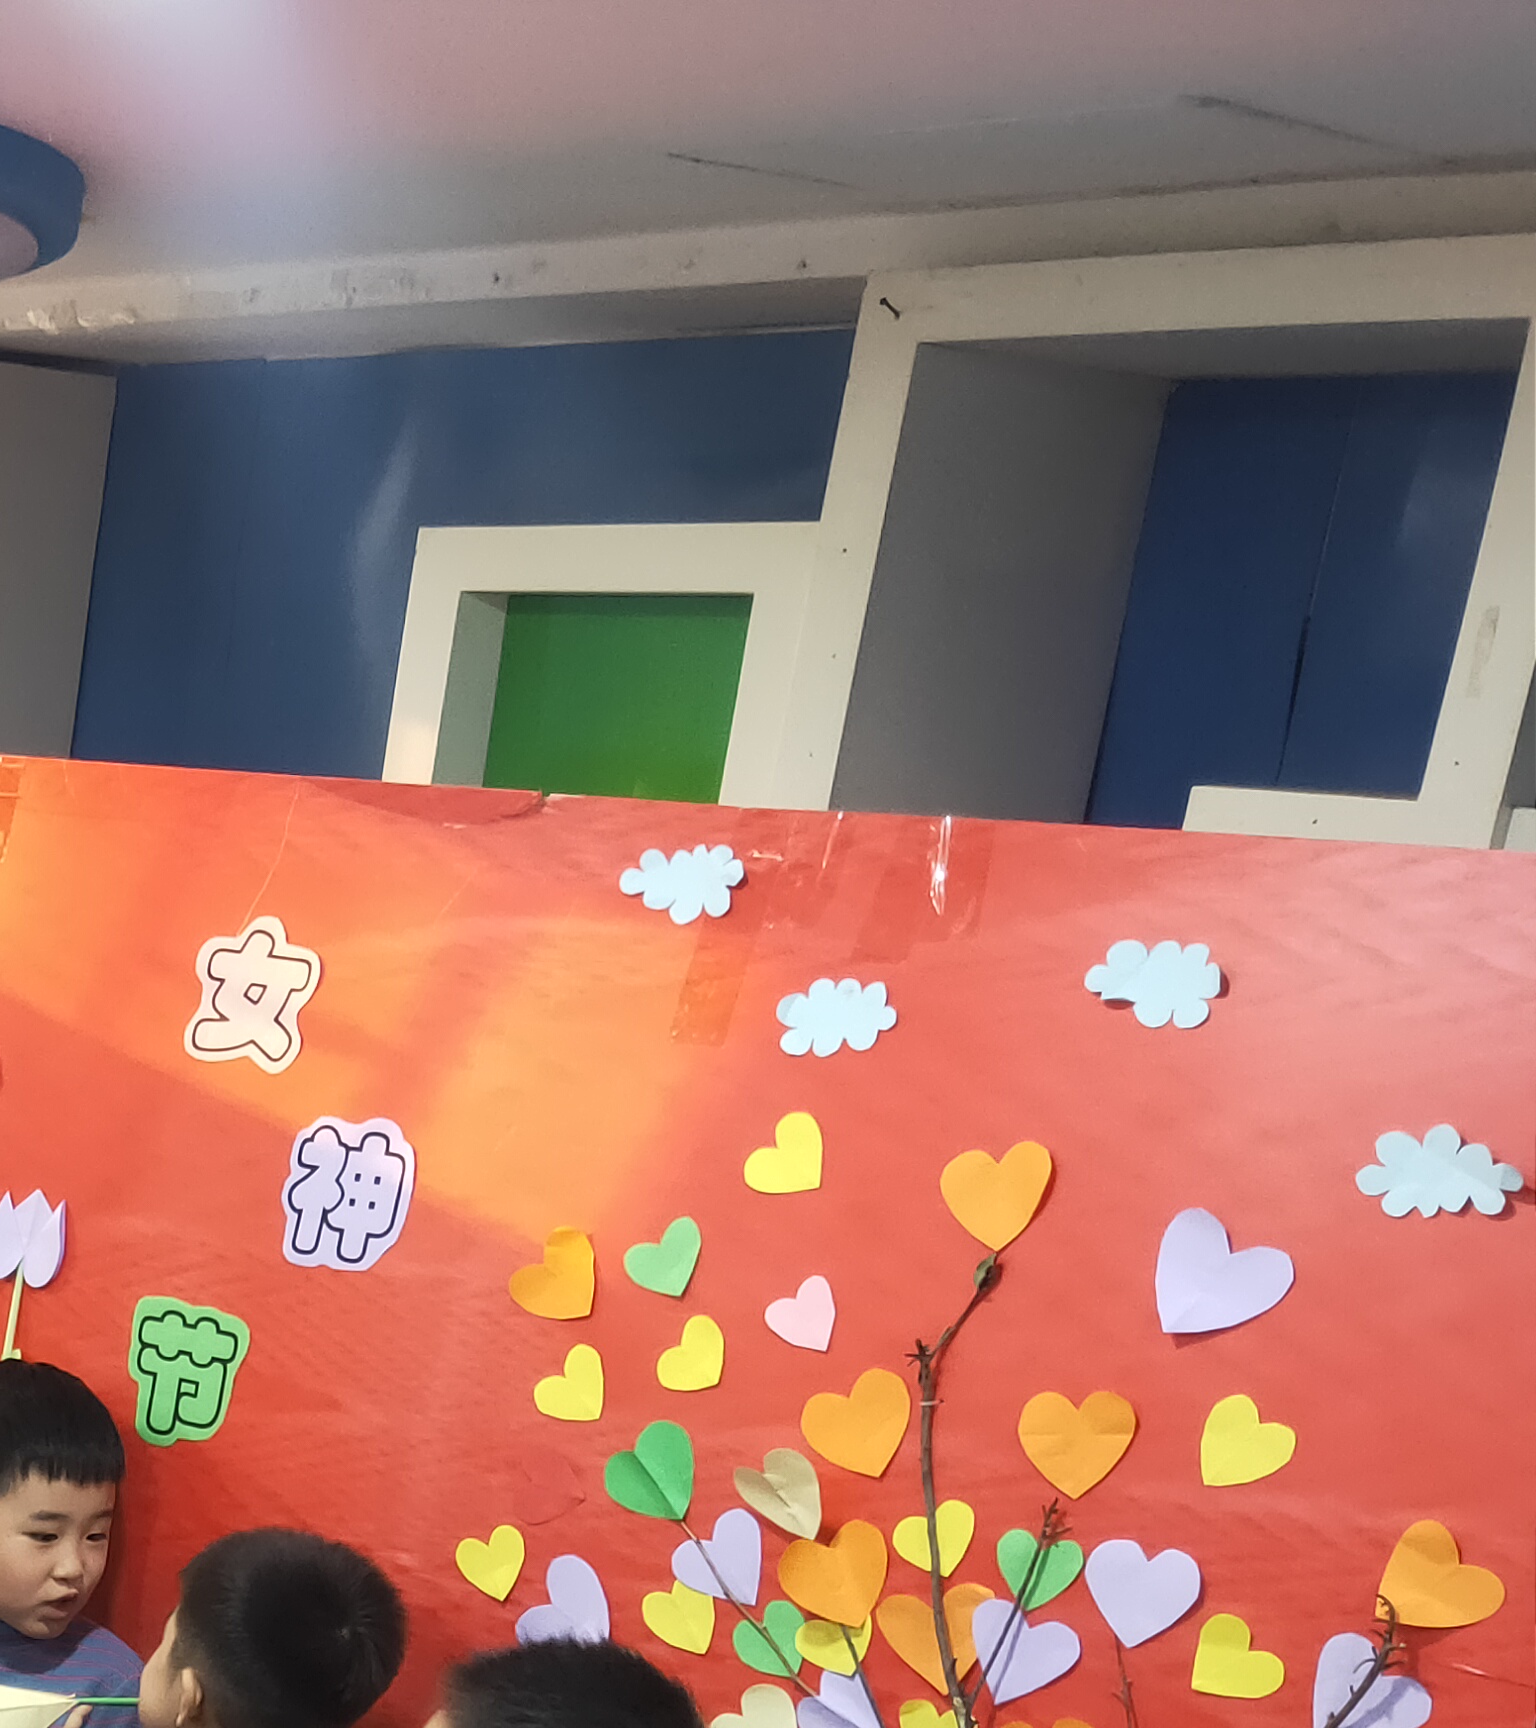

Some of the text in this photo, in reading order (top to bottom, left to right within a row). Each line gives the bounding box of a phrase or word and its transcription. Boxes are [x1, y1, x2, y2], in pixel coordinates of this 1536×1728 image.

[192, 929, 312, 1062] 女
[287, 1125, 406, 1263] 神
[137, 1310, 239, 1435] 节
